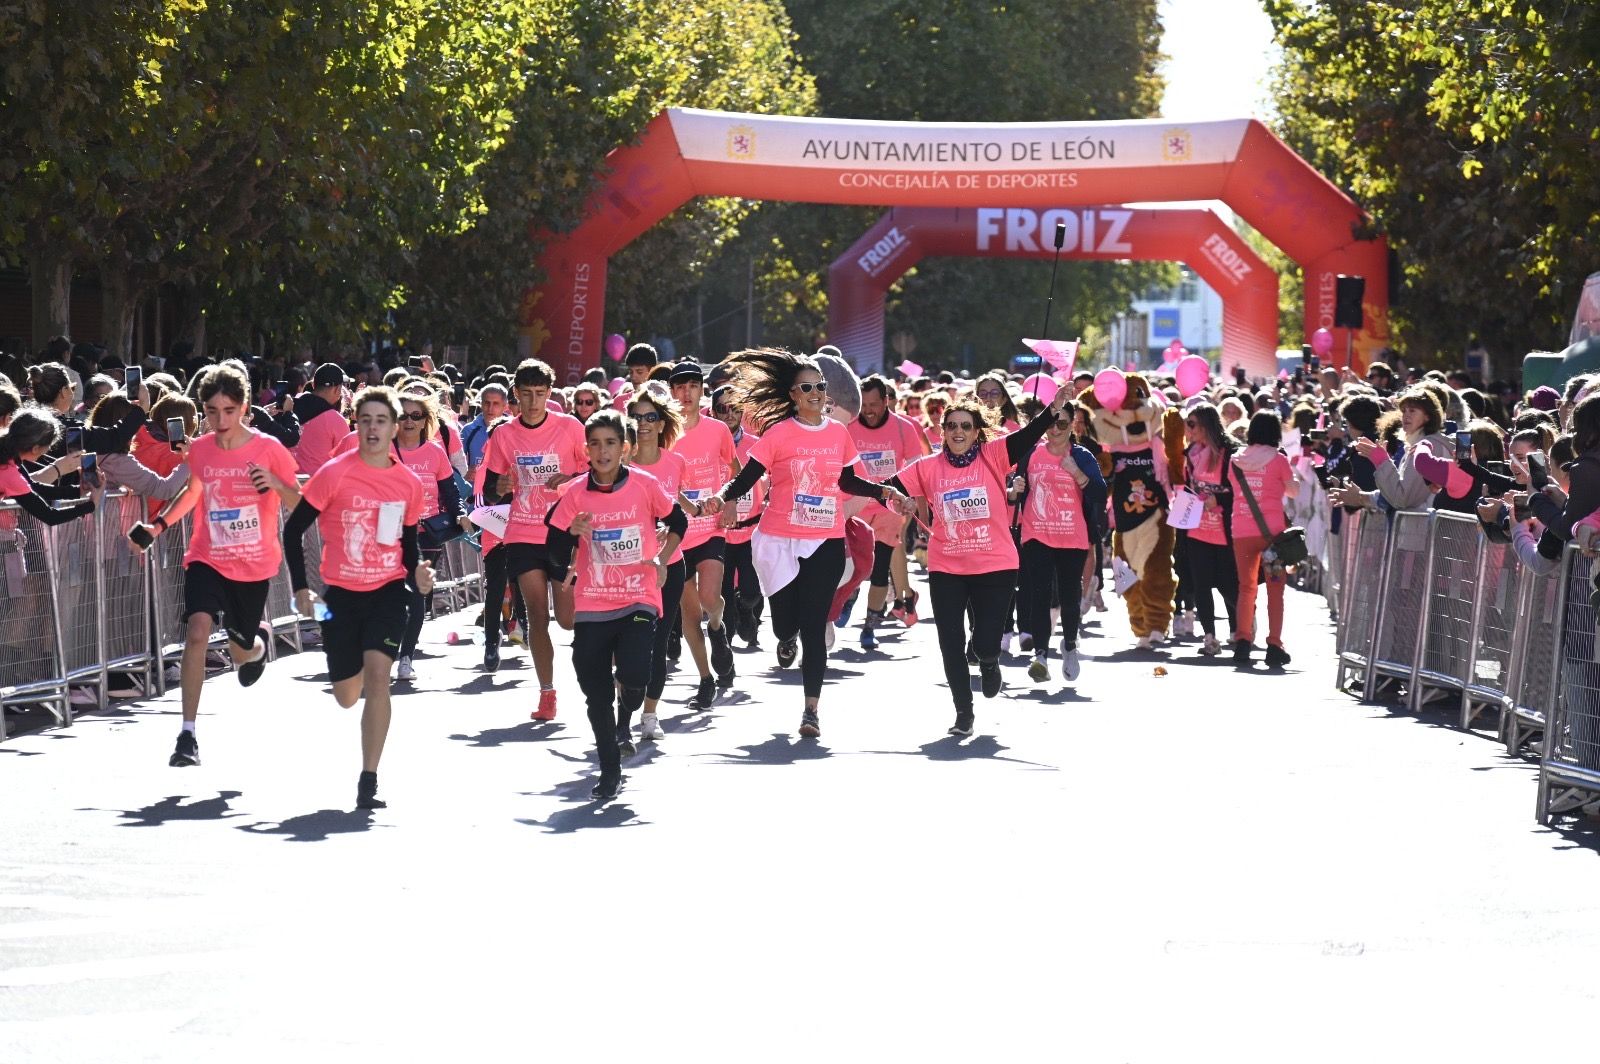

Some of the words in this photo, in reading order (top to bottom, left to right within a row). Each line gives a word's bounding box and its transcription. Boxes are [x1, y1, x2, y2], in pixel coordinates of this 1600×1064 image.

[802, 139, 1002, 162] AYUNTAMIENTO
[1011, 141, 1042, 161] DE
[1051, 136, 1115, 160] LEÓN
[839, 171, 950, 190] CONCEJALÍA
[956, 174, 980, 189] DE
[986, 173, 1078, 188] DEPORTES
[976, 207, 1134, 254] FROIZ
[857, 226, 906, 273] FROIZ
[1204, 232, 1252, 281] FROIZ
[568, 262, 590, 355] DEPORTES
[797, 444, 839, 456] Drasanvi
[532, 464, 559, 474] 0802
[874, 458, 895, 468] 0893
[939, 470, 978, 488] Drasanvi
[961, 497, 987, 508] 0000
[229, 517, 258, 531] 4916
[610, 538, 640, 552] 3607
